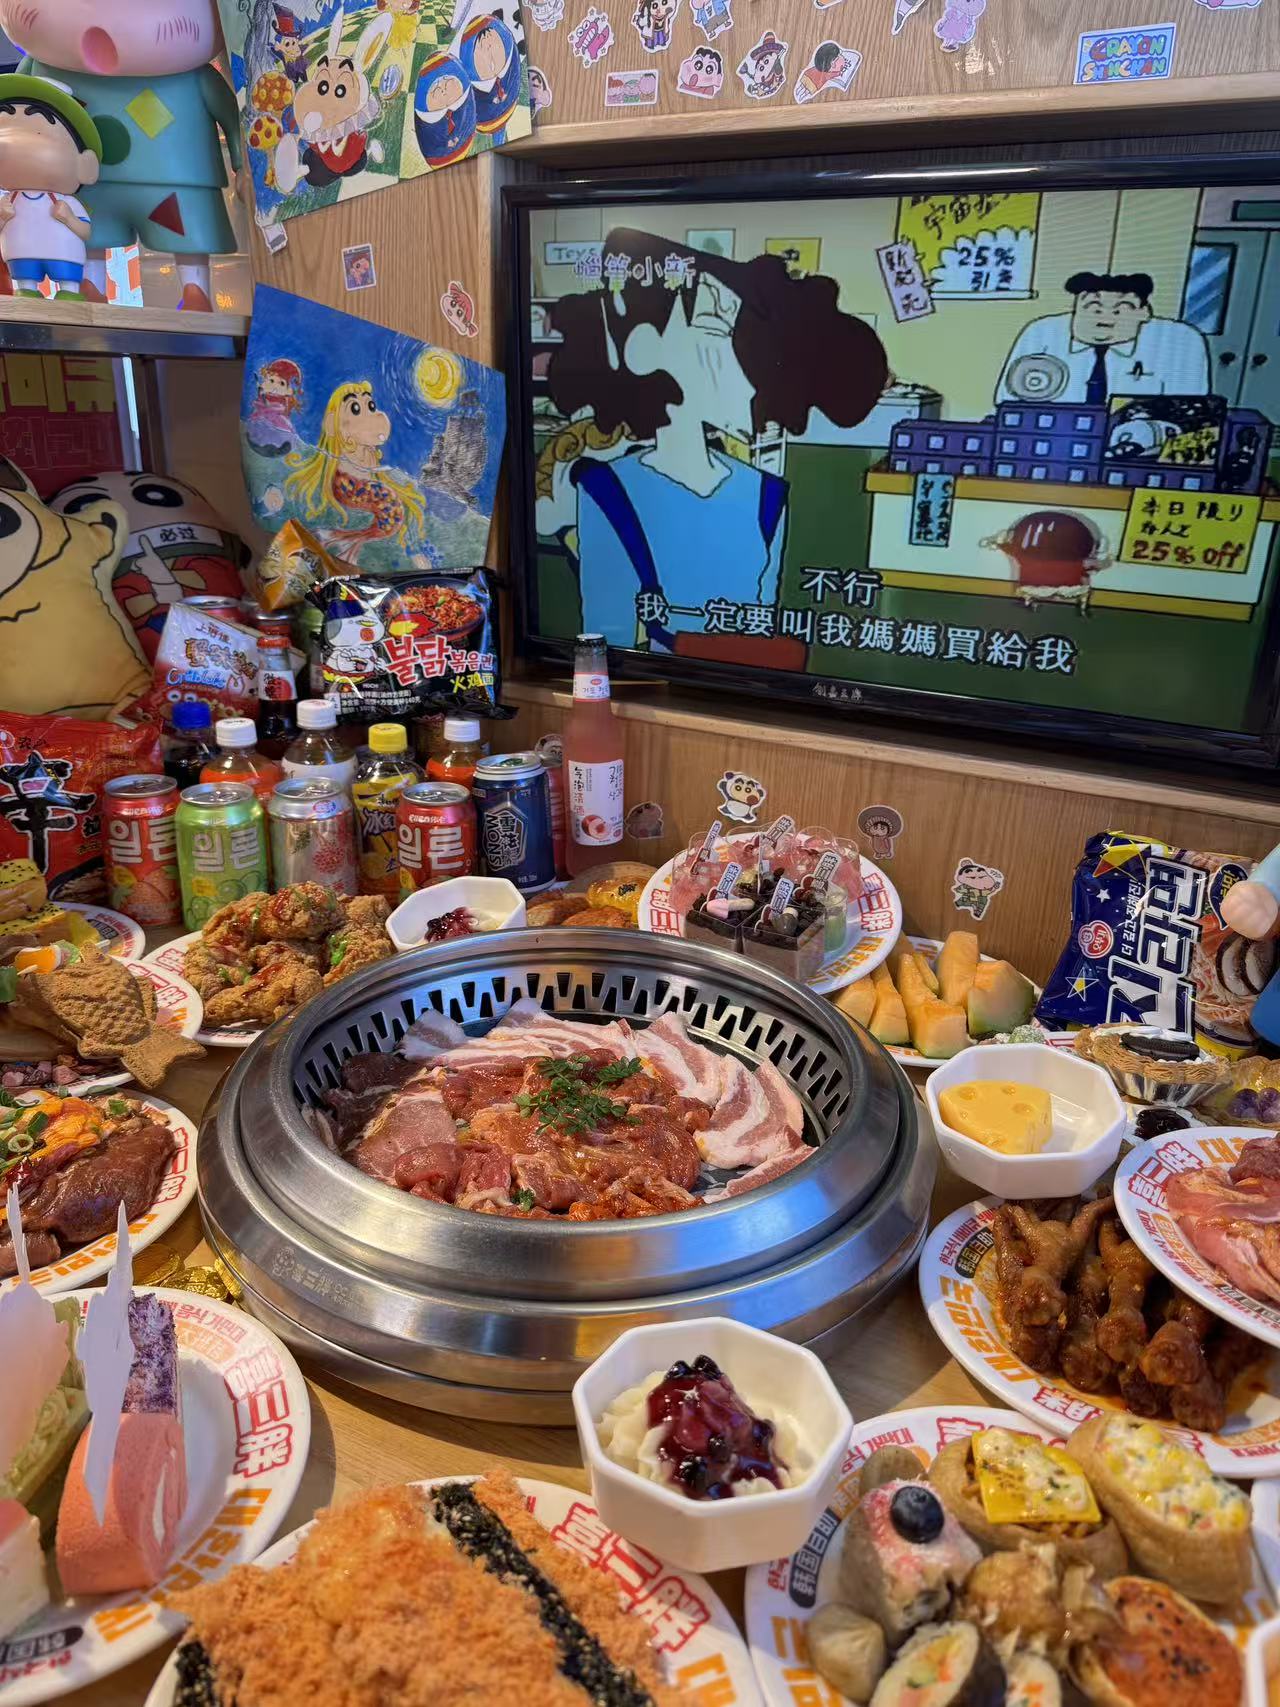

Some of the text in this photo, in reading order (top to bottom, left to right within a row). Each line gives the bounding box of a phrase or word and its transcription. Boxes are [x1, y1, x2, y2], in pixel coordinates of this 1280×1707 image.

[1089, 34, 1168, 62] CRAYON
[1081, 57, 1168, 82] SHINCHAN
[159, 526, 199, 543] 必过
[1132, 540, 1196, 565] 25%
[802, 568, 882, 606] 不行
[636, 592, 1076, 675] 我一定要叫我媽媽買給我
[450, 671, 494, 694] 火鸡面
[363, 808, 398, 837] 冰红
